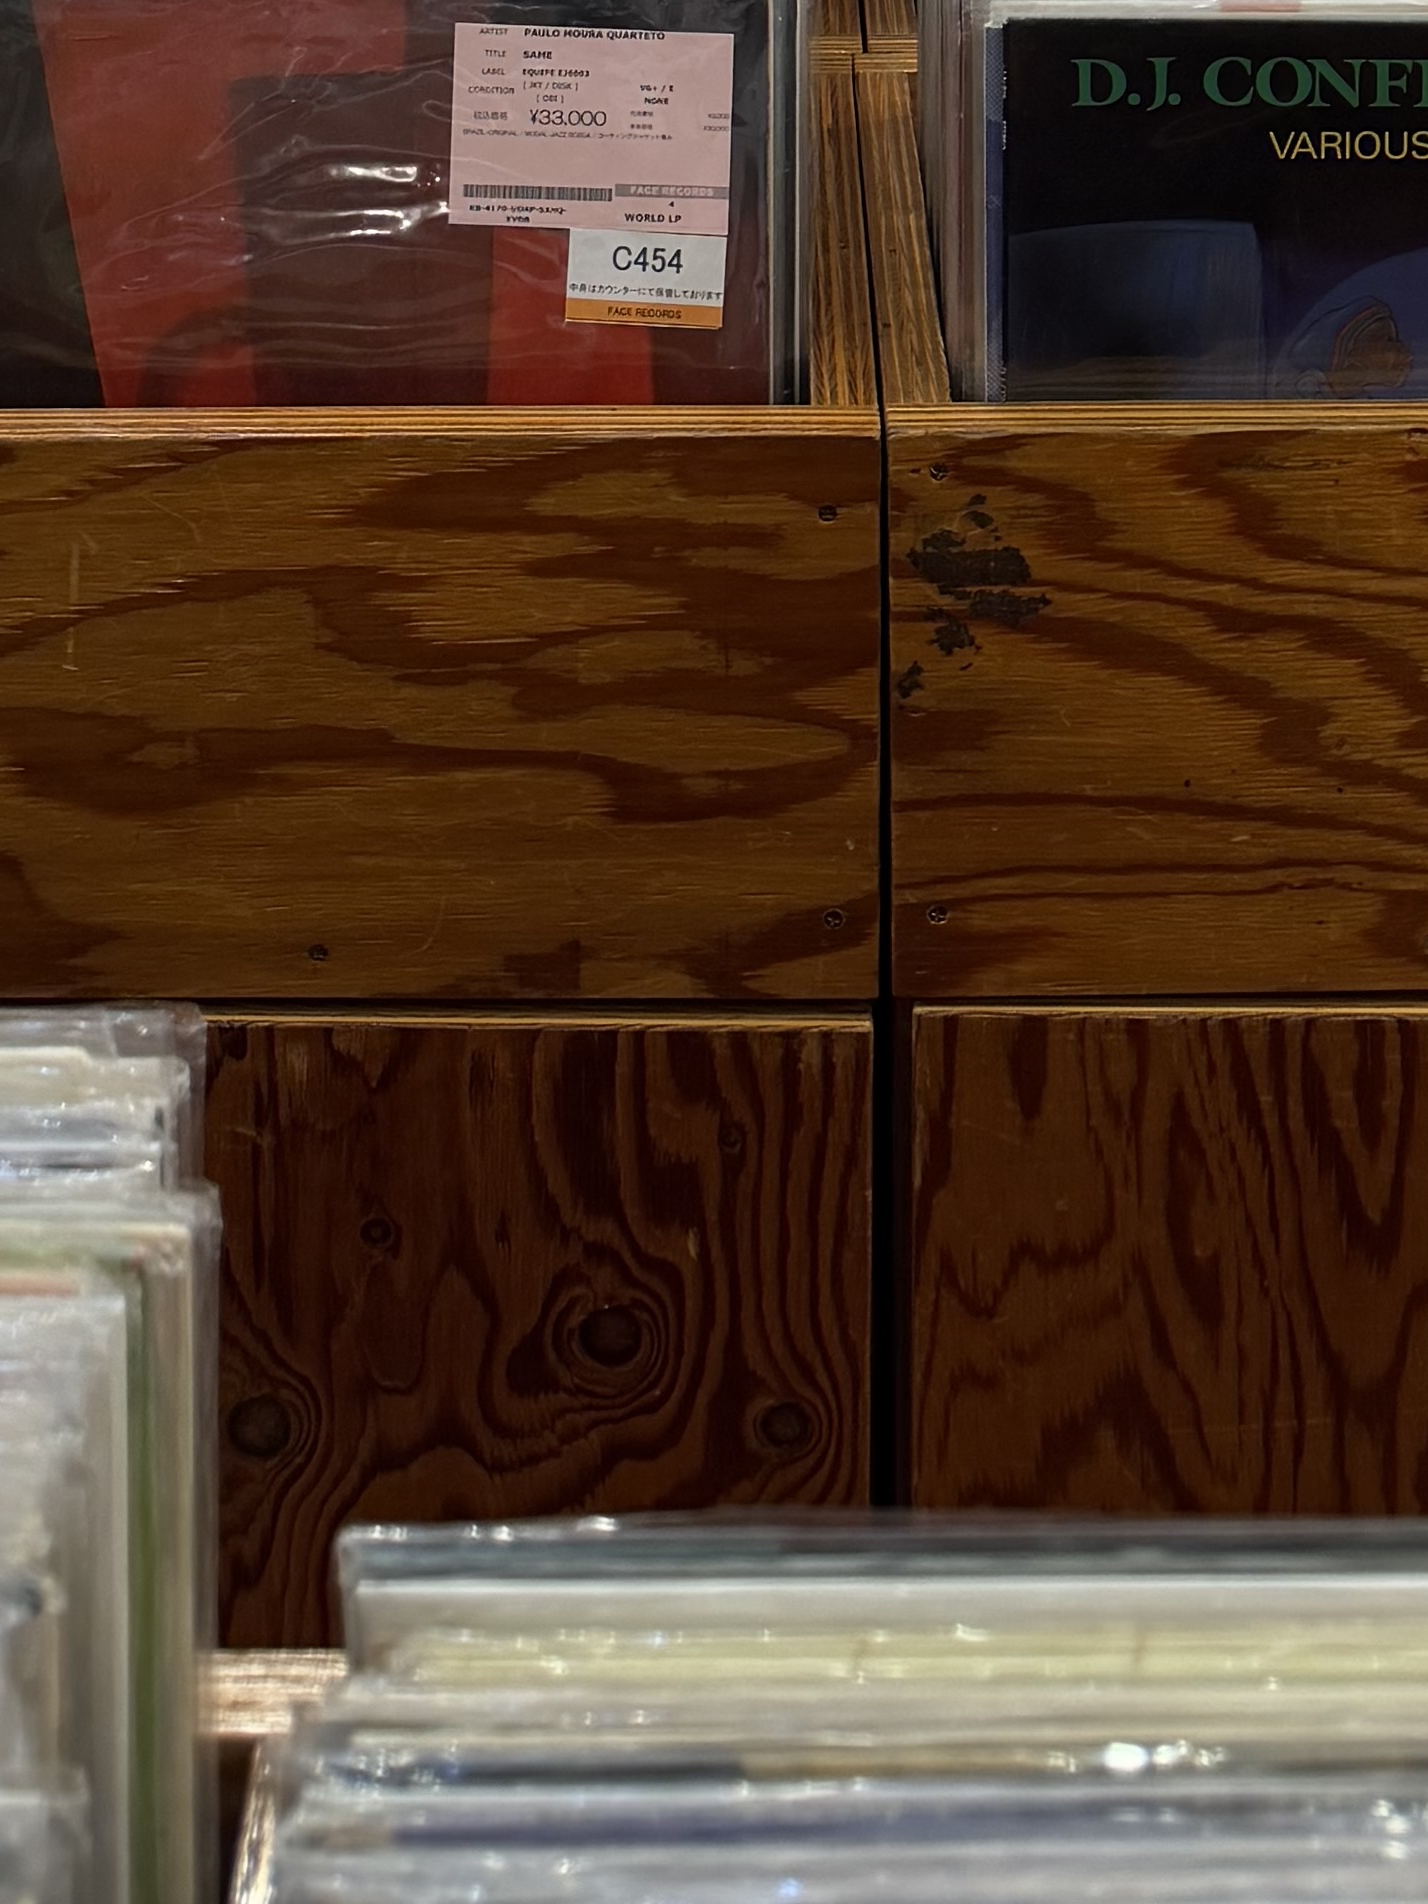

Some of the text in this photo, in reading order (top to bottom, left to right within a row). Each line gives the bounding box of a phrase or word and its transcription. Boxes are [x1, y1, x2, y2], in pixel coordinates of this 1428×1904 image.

[524, 27, 666, 41] PAULO MOURA QUARTETO
[522, 50, 553, 60] SAME
[1071, 56, 1182, 112] D.J.
[529, 108, 607, 127] ¥33,000
[624, 212, 682, 223] WORLD LP
[612, 245, 684, 275] C454
[607, 306, 682, 319] FACE RECORDS
